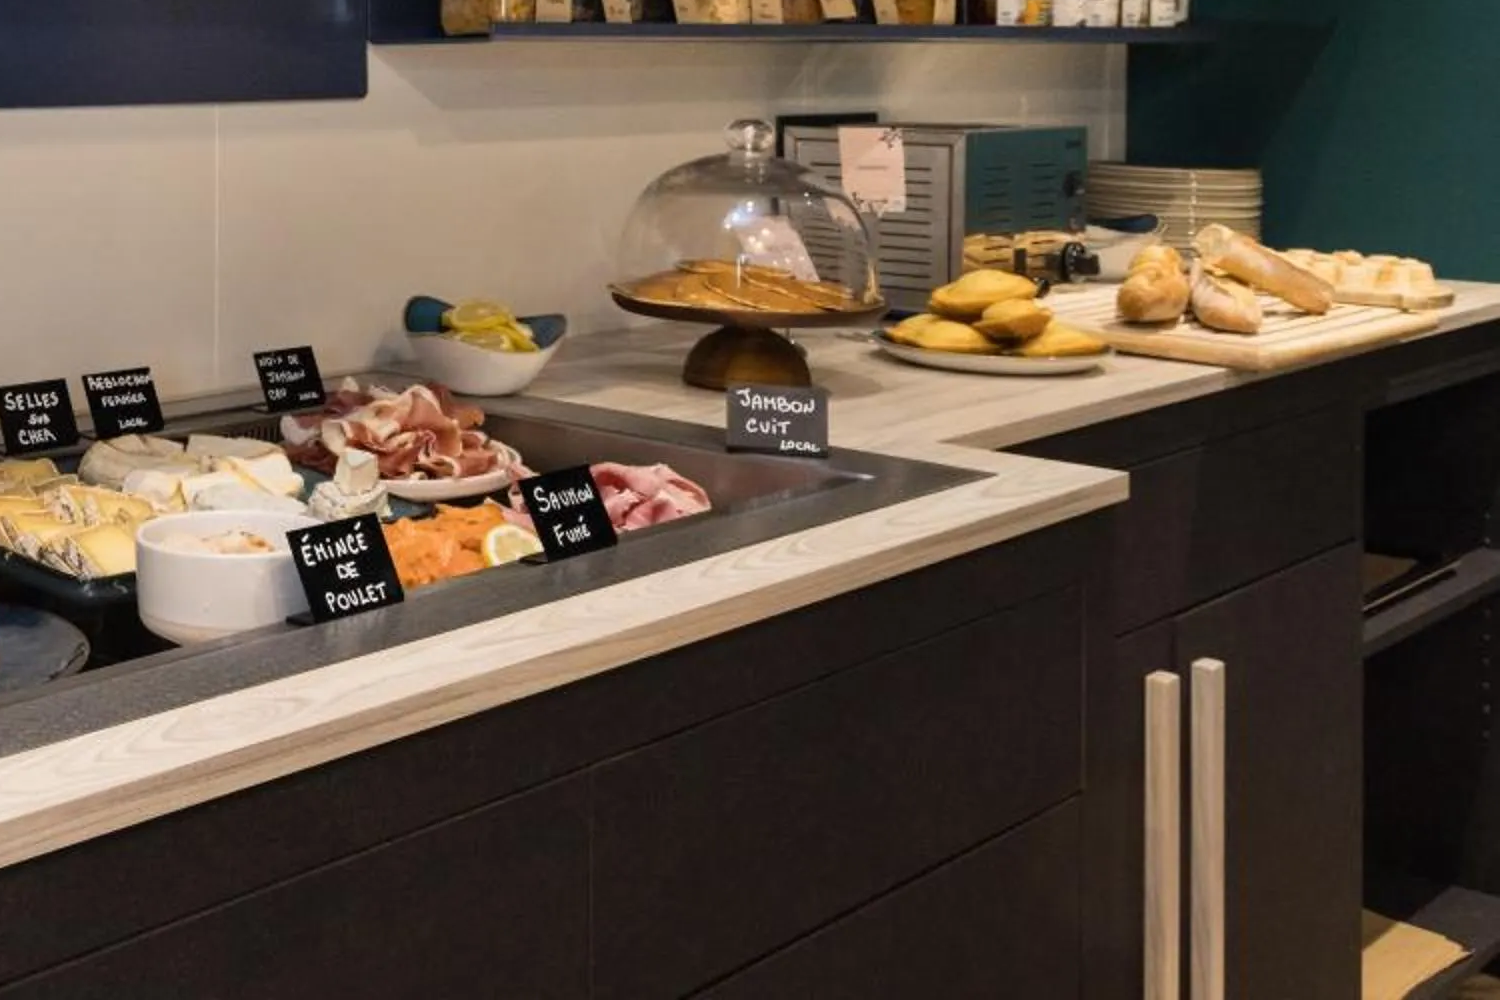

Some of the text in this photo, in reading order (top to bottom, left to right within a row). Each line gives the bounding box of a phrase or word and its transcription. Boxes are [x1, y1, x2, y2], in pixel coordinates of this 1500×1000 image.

[3, 391, 59, 411] SELLES
[735, 387, 815, 414] JAMBON
[779, 439, 821, 453] LOCAL
[335, 560, 360, 580] DE
[324, 581, 387, 613] POULET
